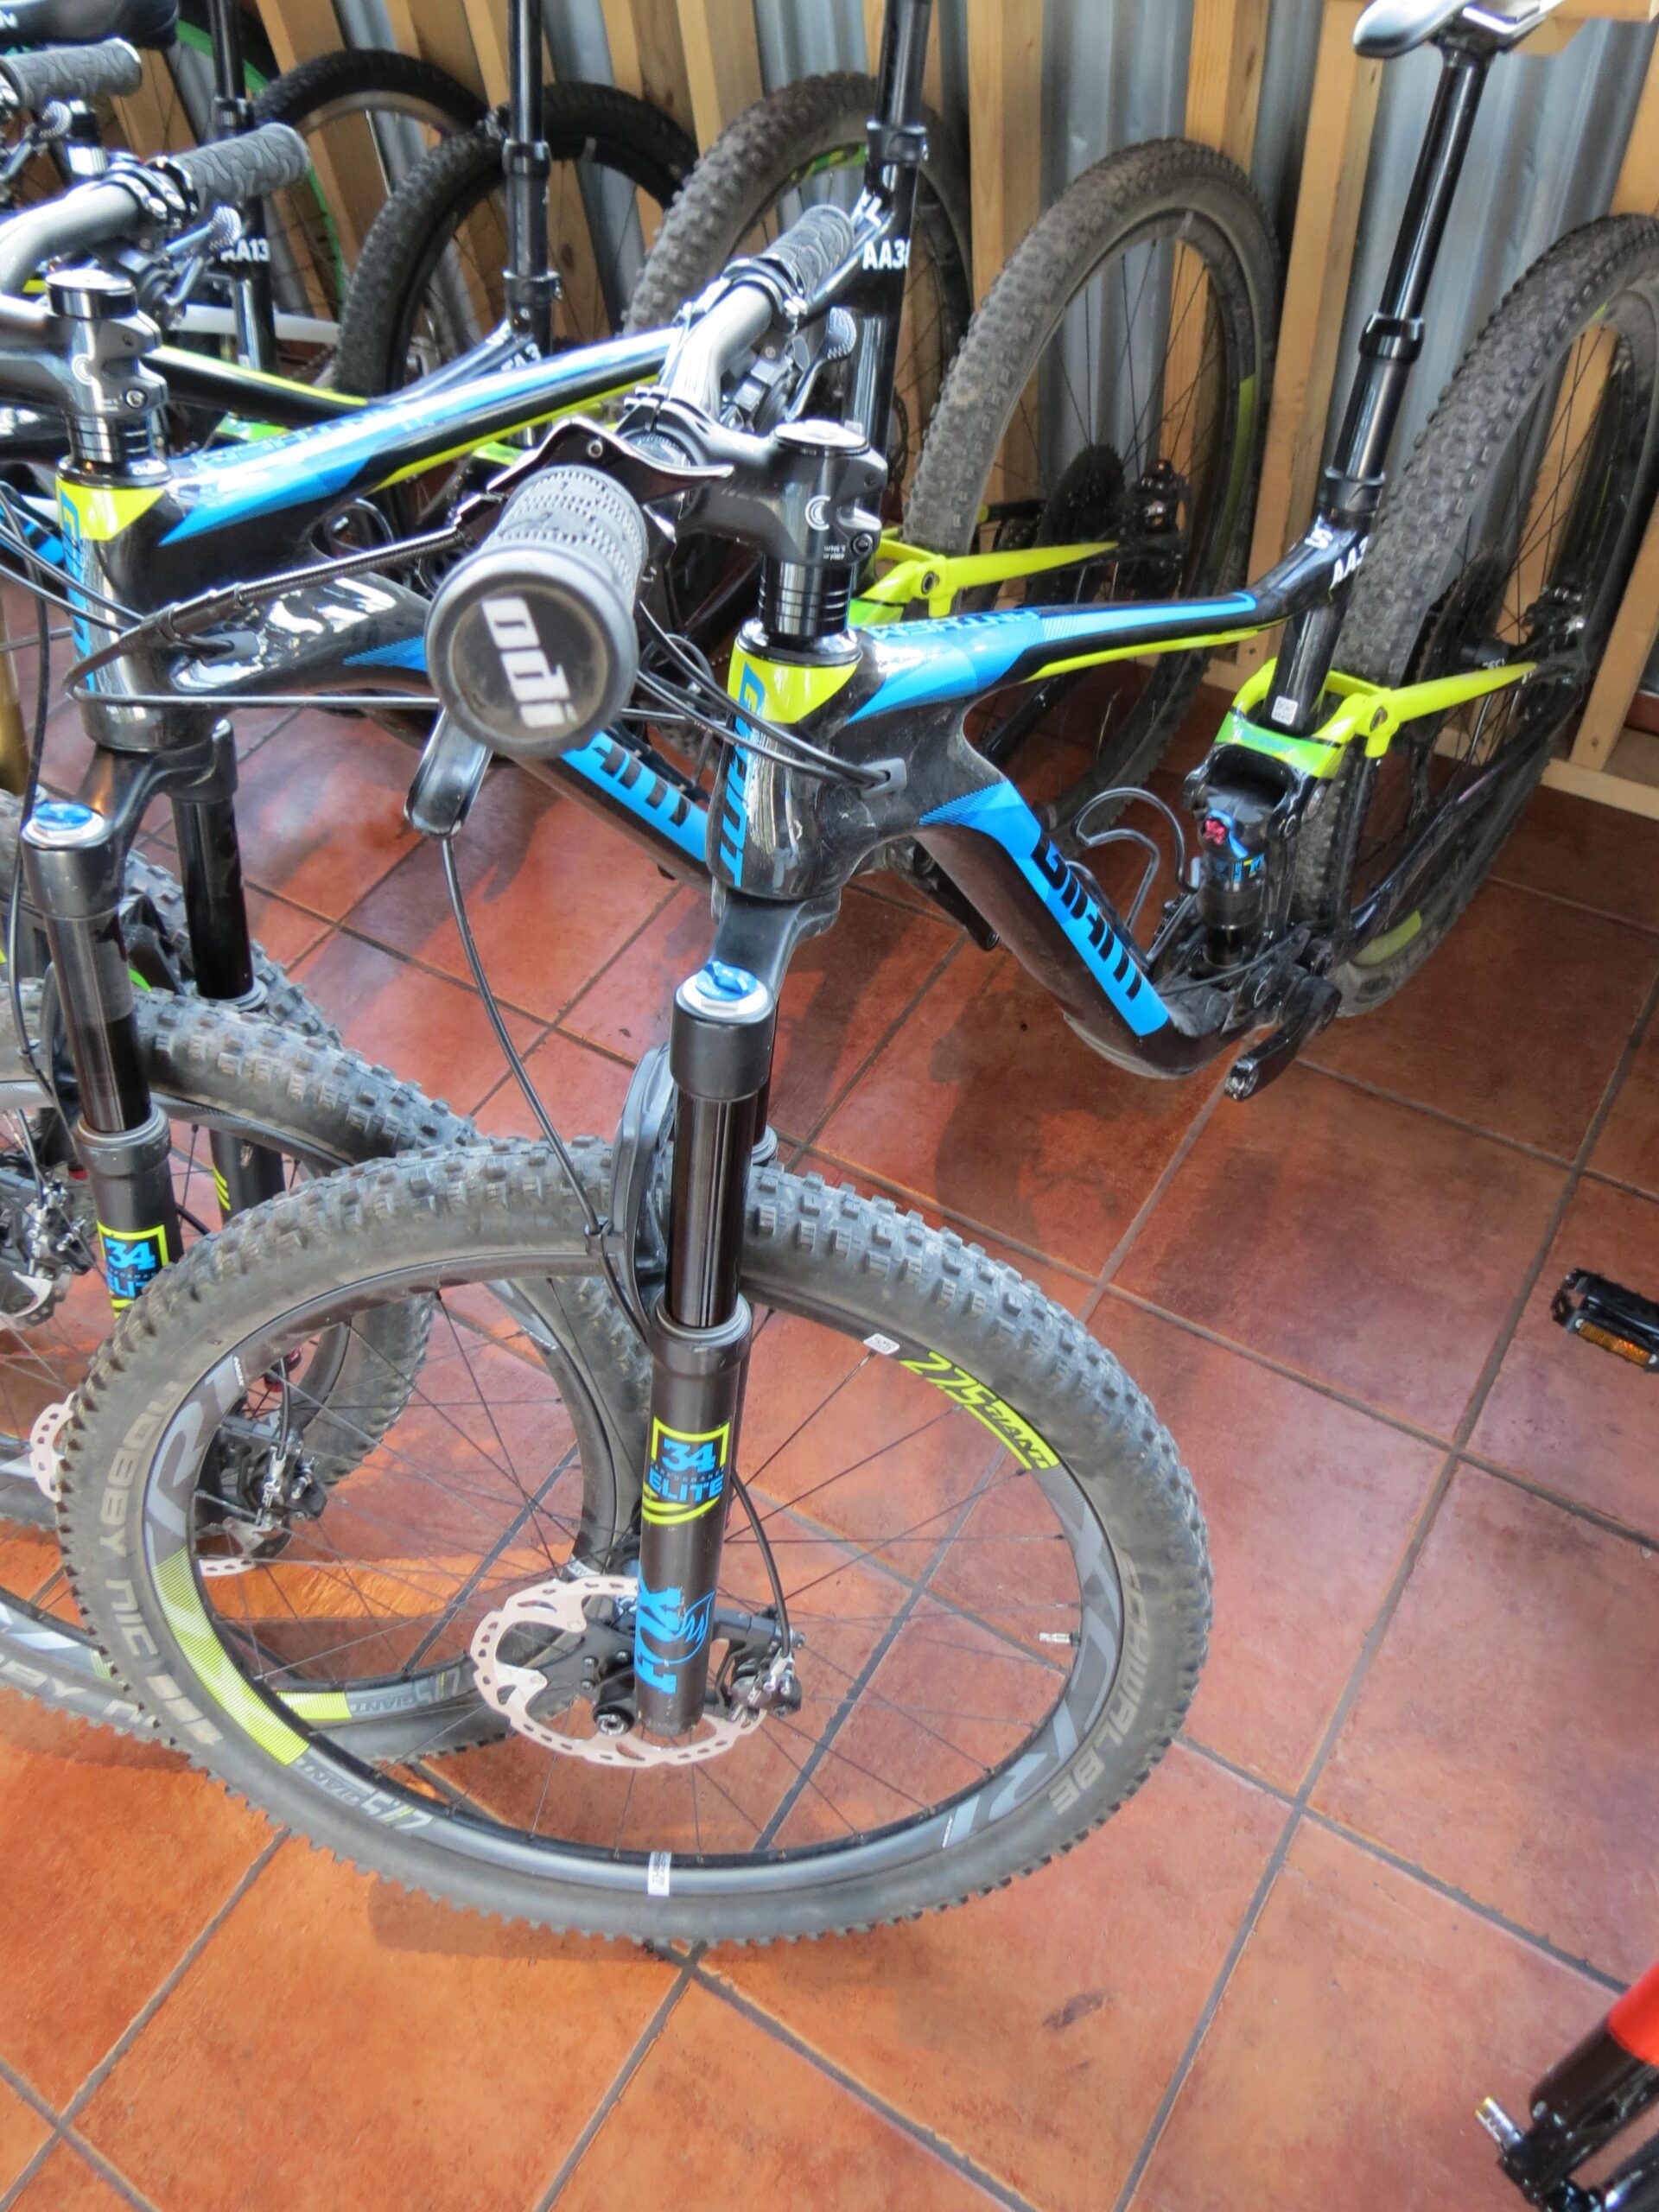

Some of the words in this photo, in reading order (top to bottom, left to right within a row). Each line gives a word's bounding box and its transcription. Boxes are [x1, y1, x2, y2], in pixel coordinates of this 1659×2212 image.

[105, 1237, 156, 1270] 34
[661, 1437, 716, 1473] 34
[648, 1466, 724, 1503] ELITE
[105, 1578, 159, 1657] NIC
[1048, 1549, 1150, 1815] SCHWALBE
